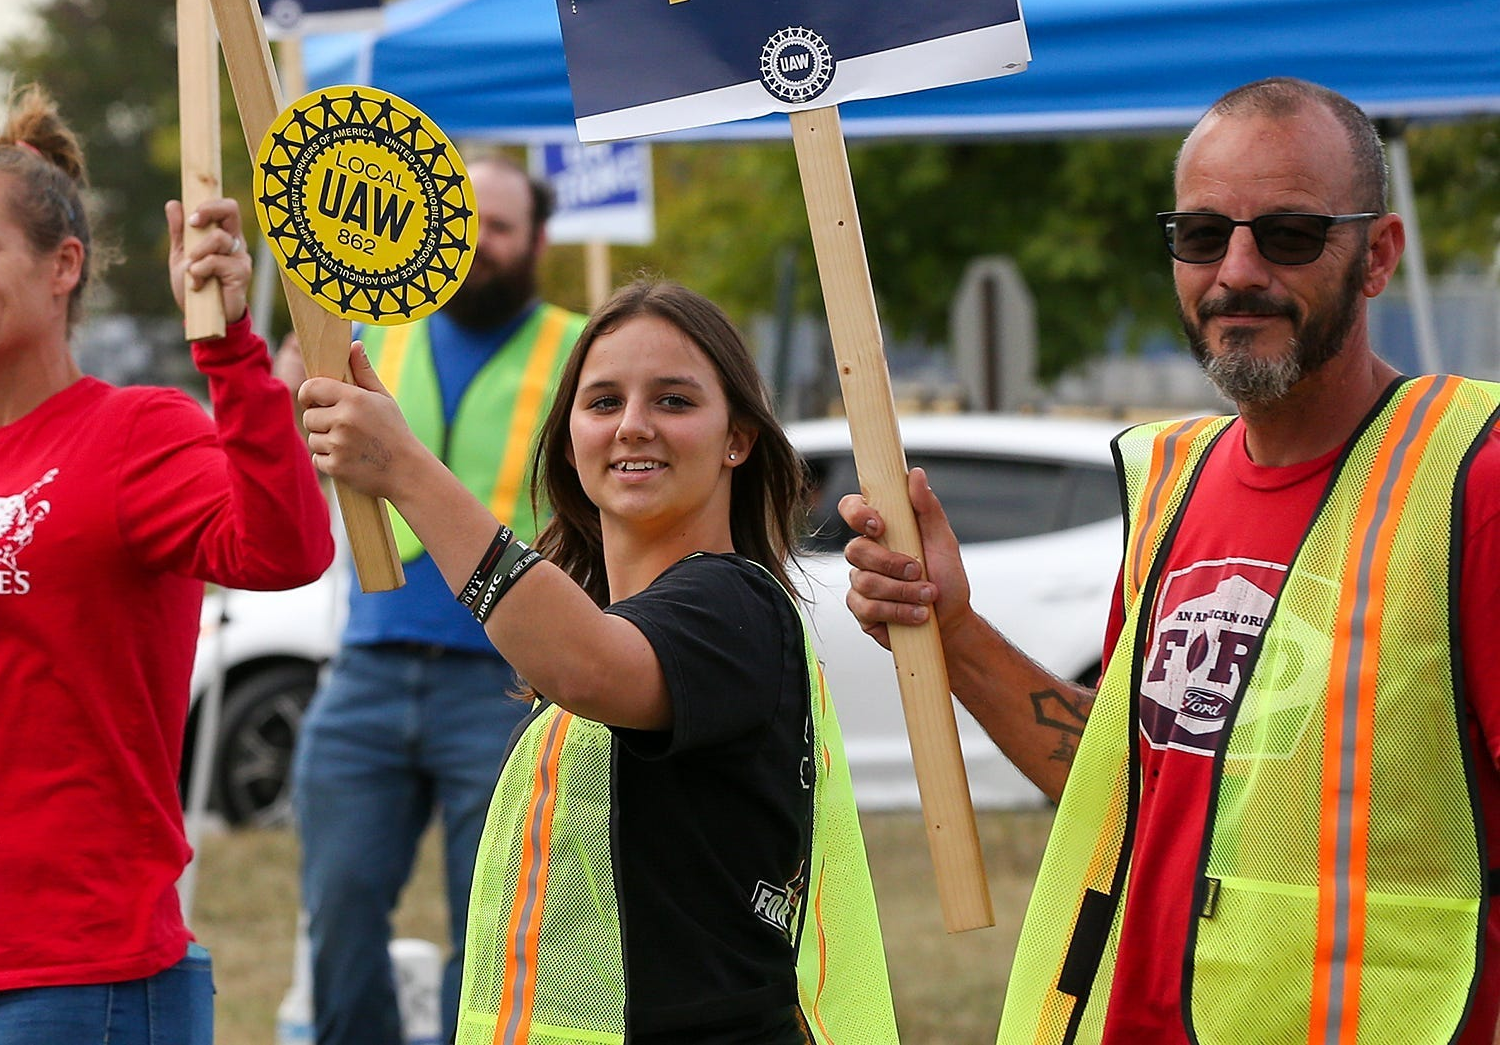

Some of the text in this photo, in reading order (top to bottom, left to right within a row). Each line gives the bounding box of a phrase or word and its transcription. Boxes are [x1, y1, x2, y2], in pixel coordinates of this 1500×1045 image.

[780, 53, 809, 73] UAW
[336, 150, 407, 193] LOCAL
[290, 127, 440, 286] UNITED AUTOMOBILE, AEROSPACE AND AGRICULTURAL IMPLEMENT WORKERS OF AMERICA
[318, 167, 415, 243] UAW
[337, 228, 377, 256] 862
[478, 573, 503, 618] JROTC
[1176, 611, 1193, 622] AN
[1185, 691, 1223, 717] Ford
